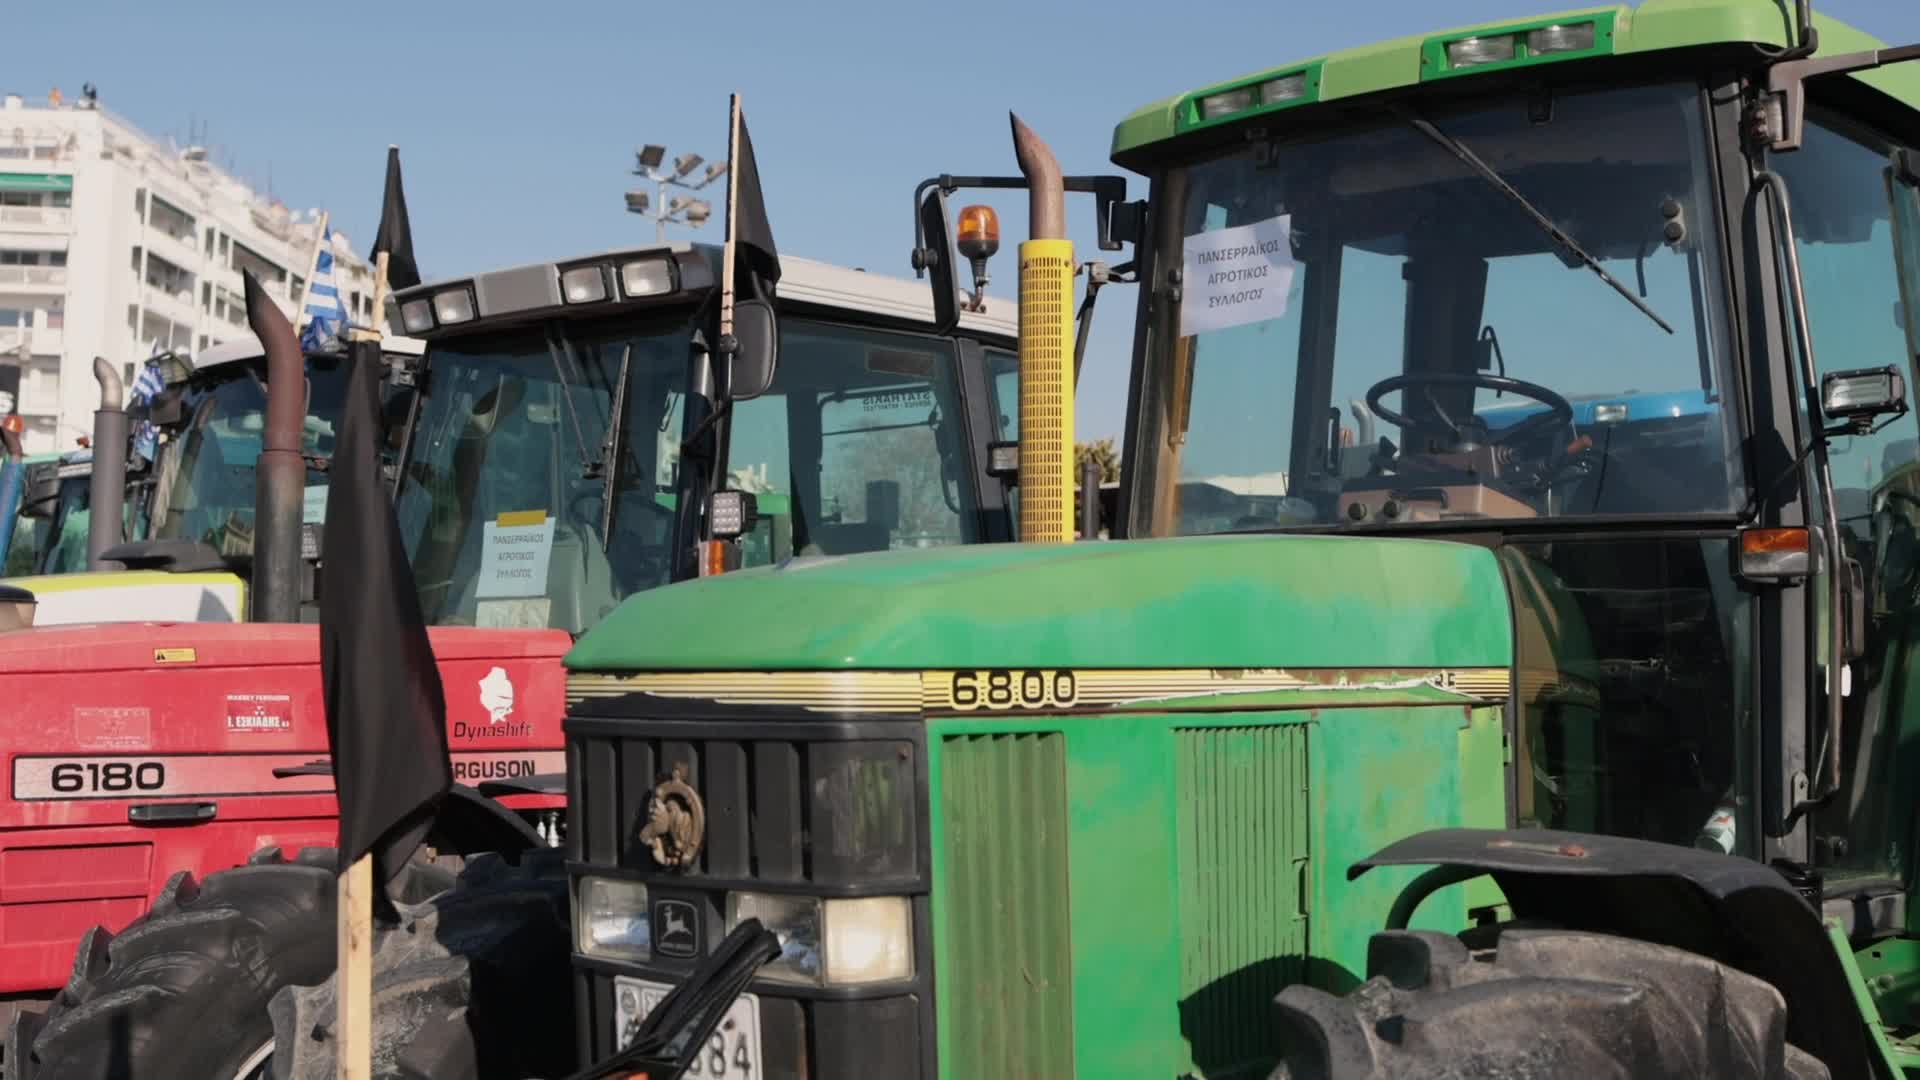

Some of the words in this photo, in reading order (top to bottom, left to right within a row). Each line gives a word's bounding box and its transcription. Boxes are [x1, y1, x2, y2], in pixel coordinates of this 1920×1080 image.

[1207, 264, 1269, 287] ΑΓΡΟΤΙΚΟΣ
[1208, 287, 1265, 309] ΣΥΛΛΟΓΟΣ
[952, 669, 1075, 705] 6800
[453, 721, 534, 741] Dynashift
[51, 762, 165, 792] 6180
[450, 760, 536, 780] RGUSON
